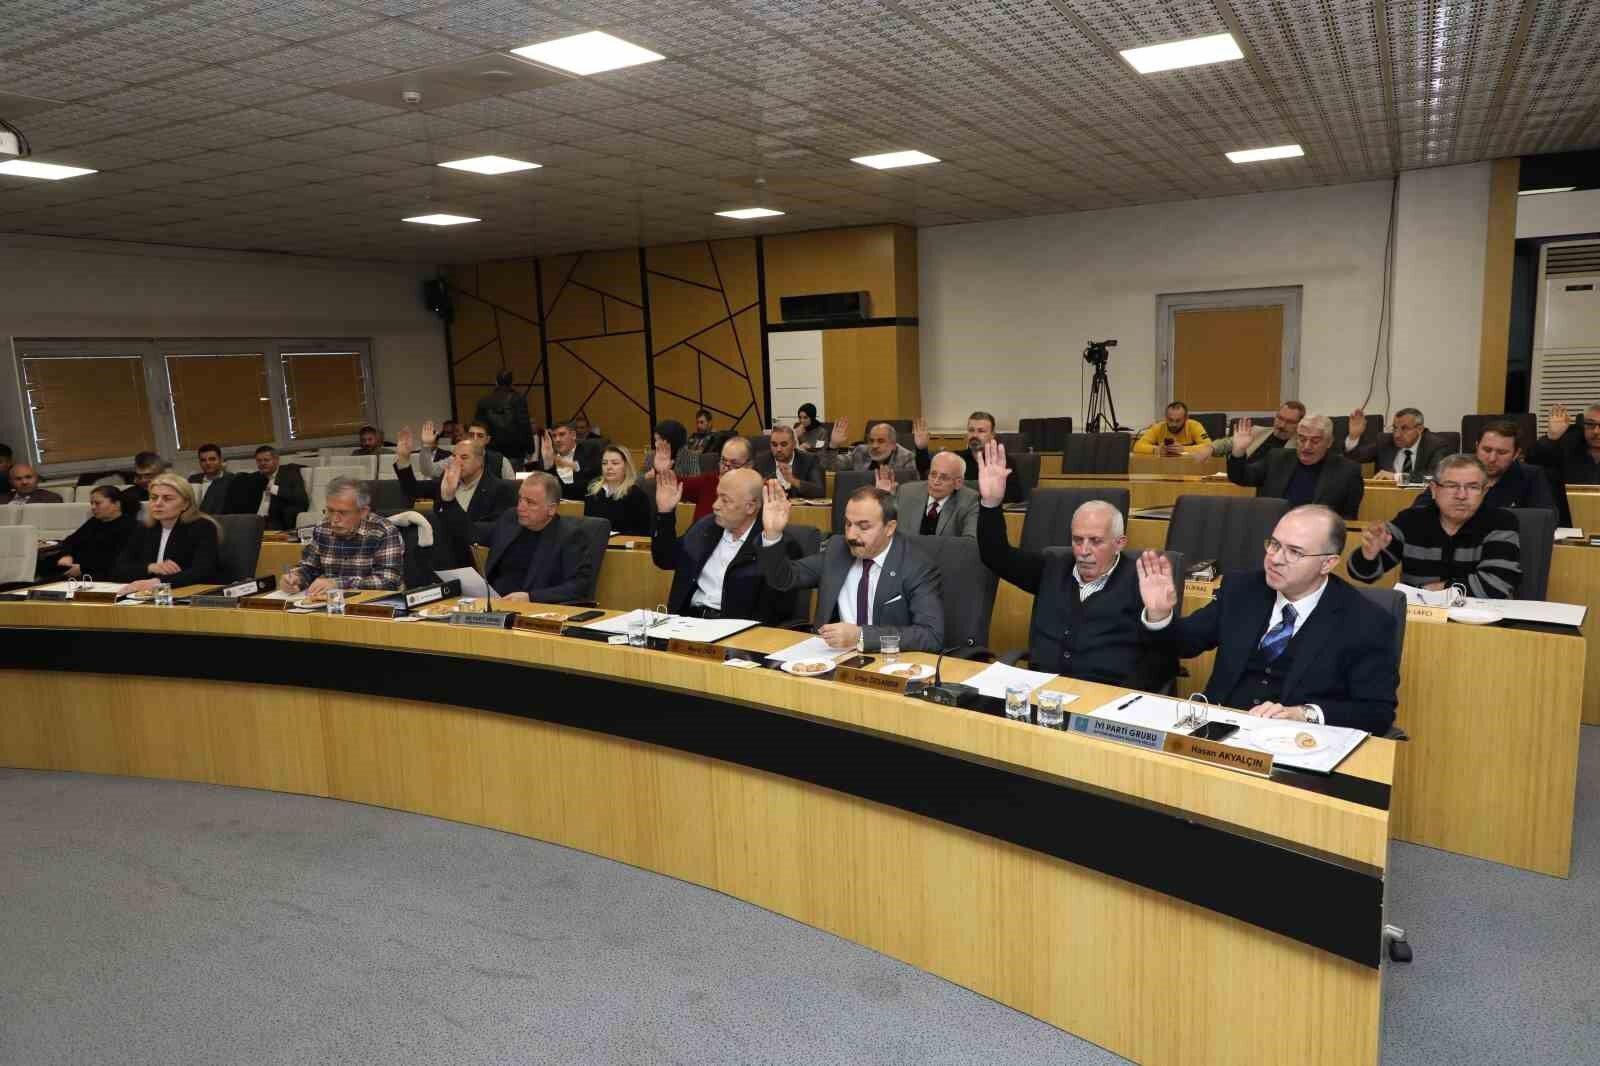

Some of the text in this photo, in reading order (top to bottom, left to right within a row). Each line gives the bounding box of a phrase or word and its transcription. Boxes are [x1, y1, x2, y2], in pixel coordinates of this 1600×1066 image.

[1129, 728, 1157, 742] GRUBU
[1191, 743, 1264, 769] Hasan AKYALÇIN
